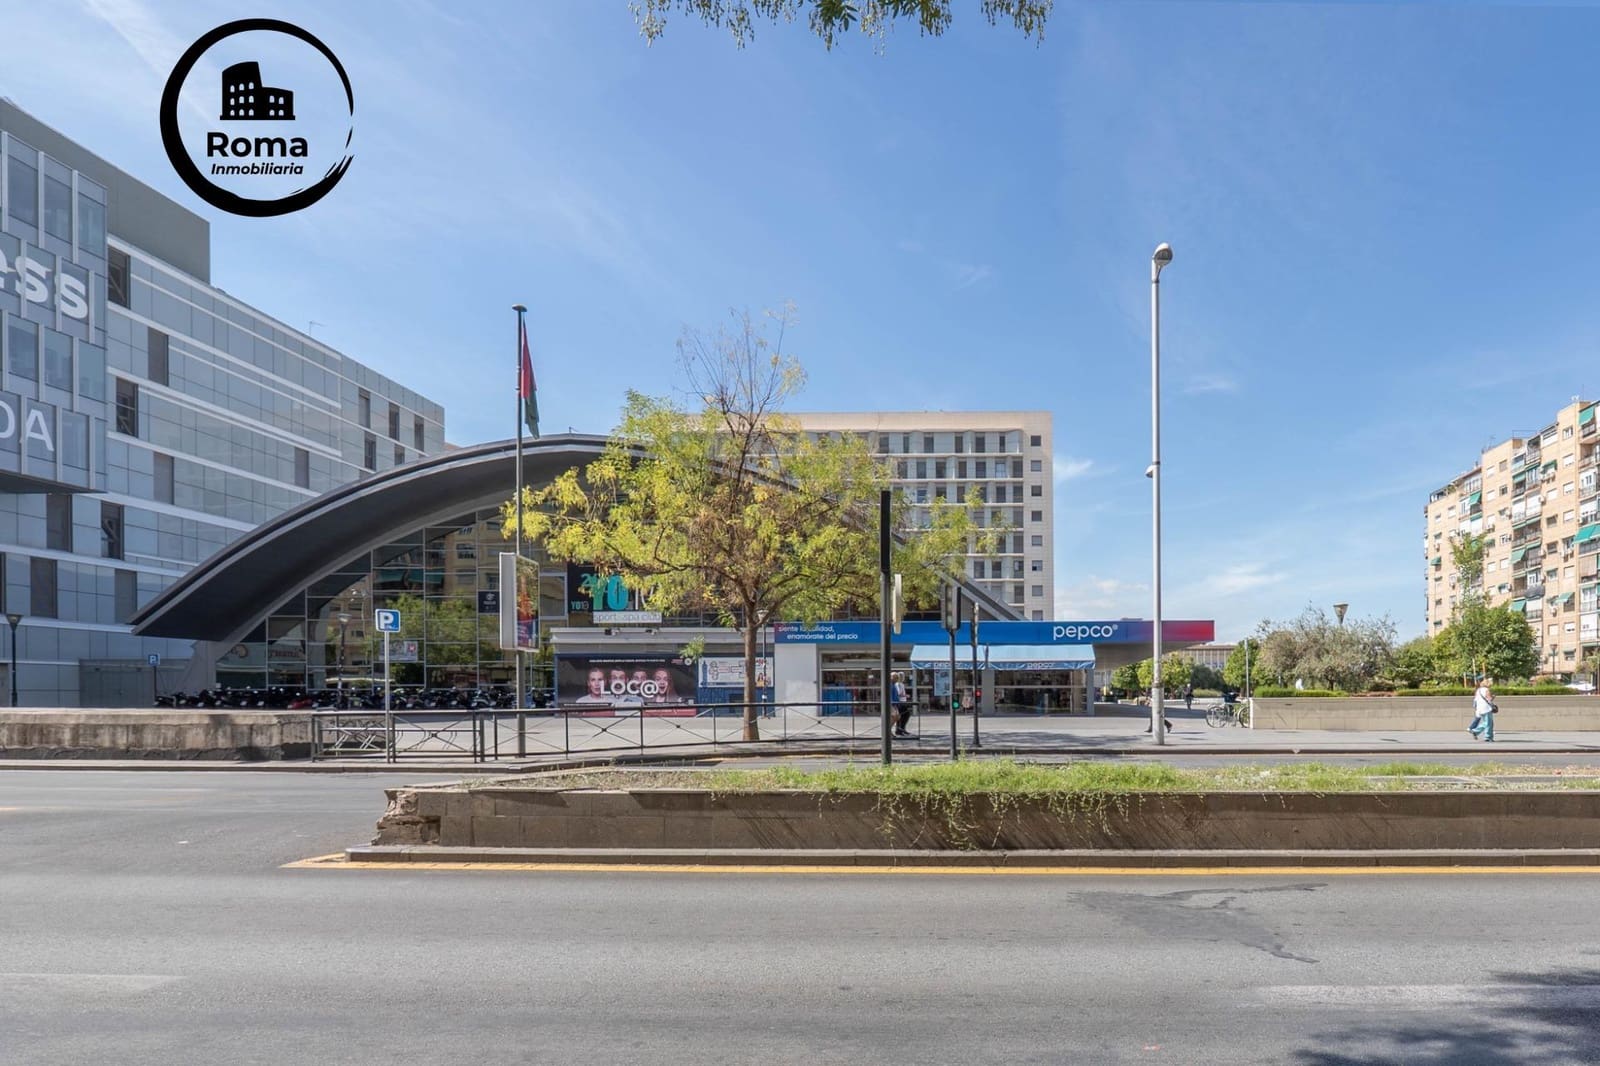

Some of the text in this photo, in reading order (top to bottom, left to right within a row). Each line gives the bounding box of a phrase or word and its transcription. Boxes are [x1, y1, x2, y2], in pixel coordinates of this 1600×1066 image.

[379, 612, 394, 630] P
[787, 632, 824, 640] enamórate
[837, 632, 859, 640] precio
[149, 655, 157, 664] P
[600, 679, 659, 697] LOC@
